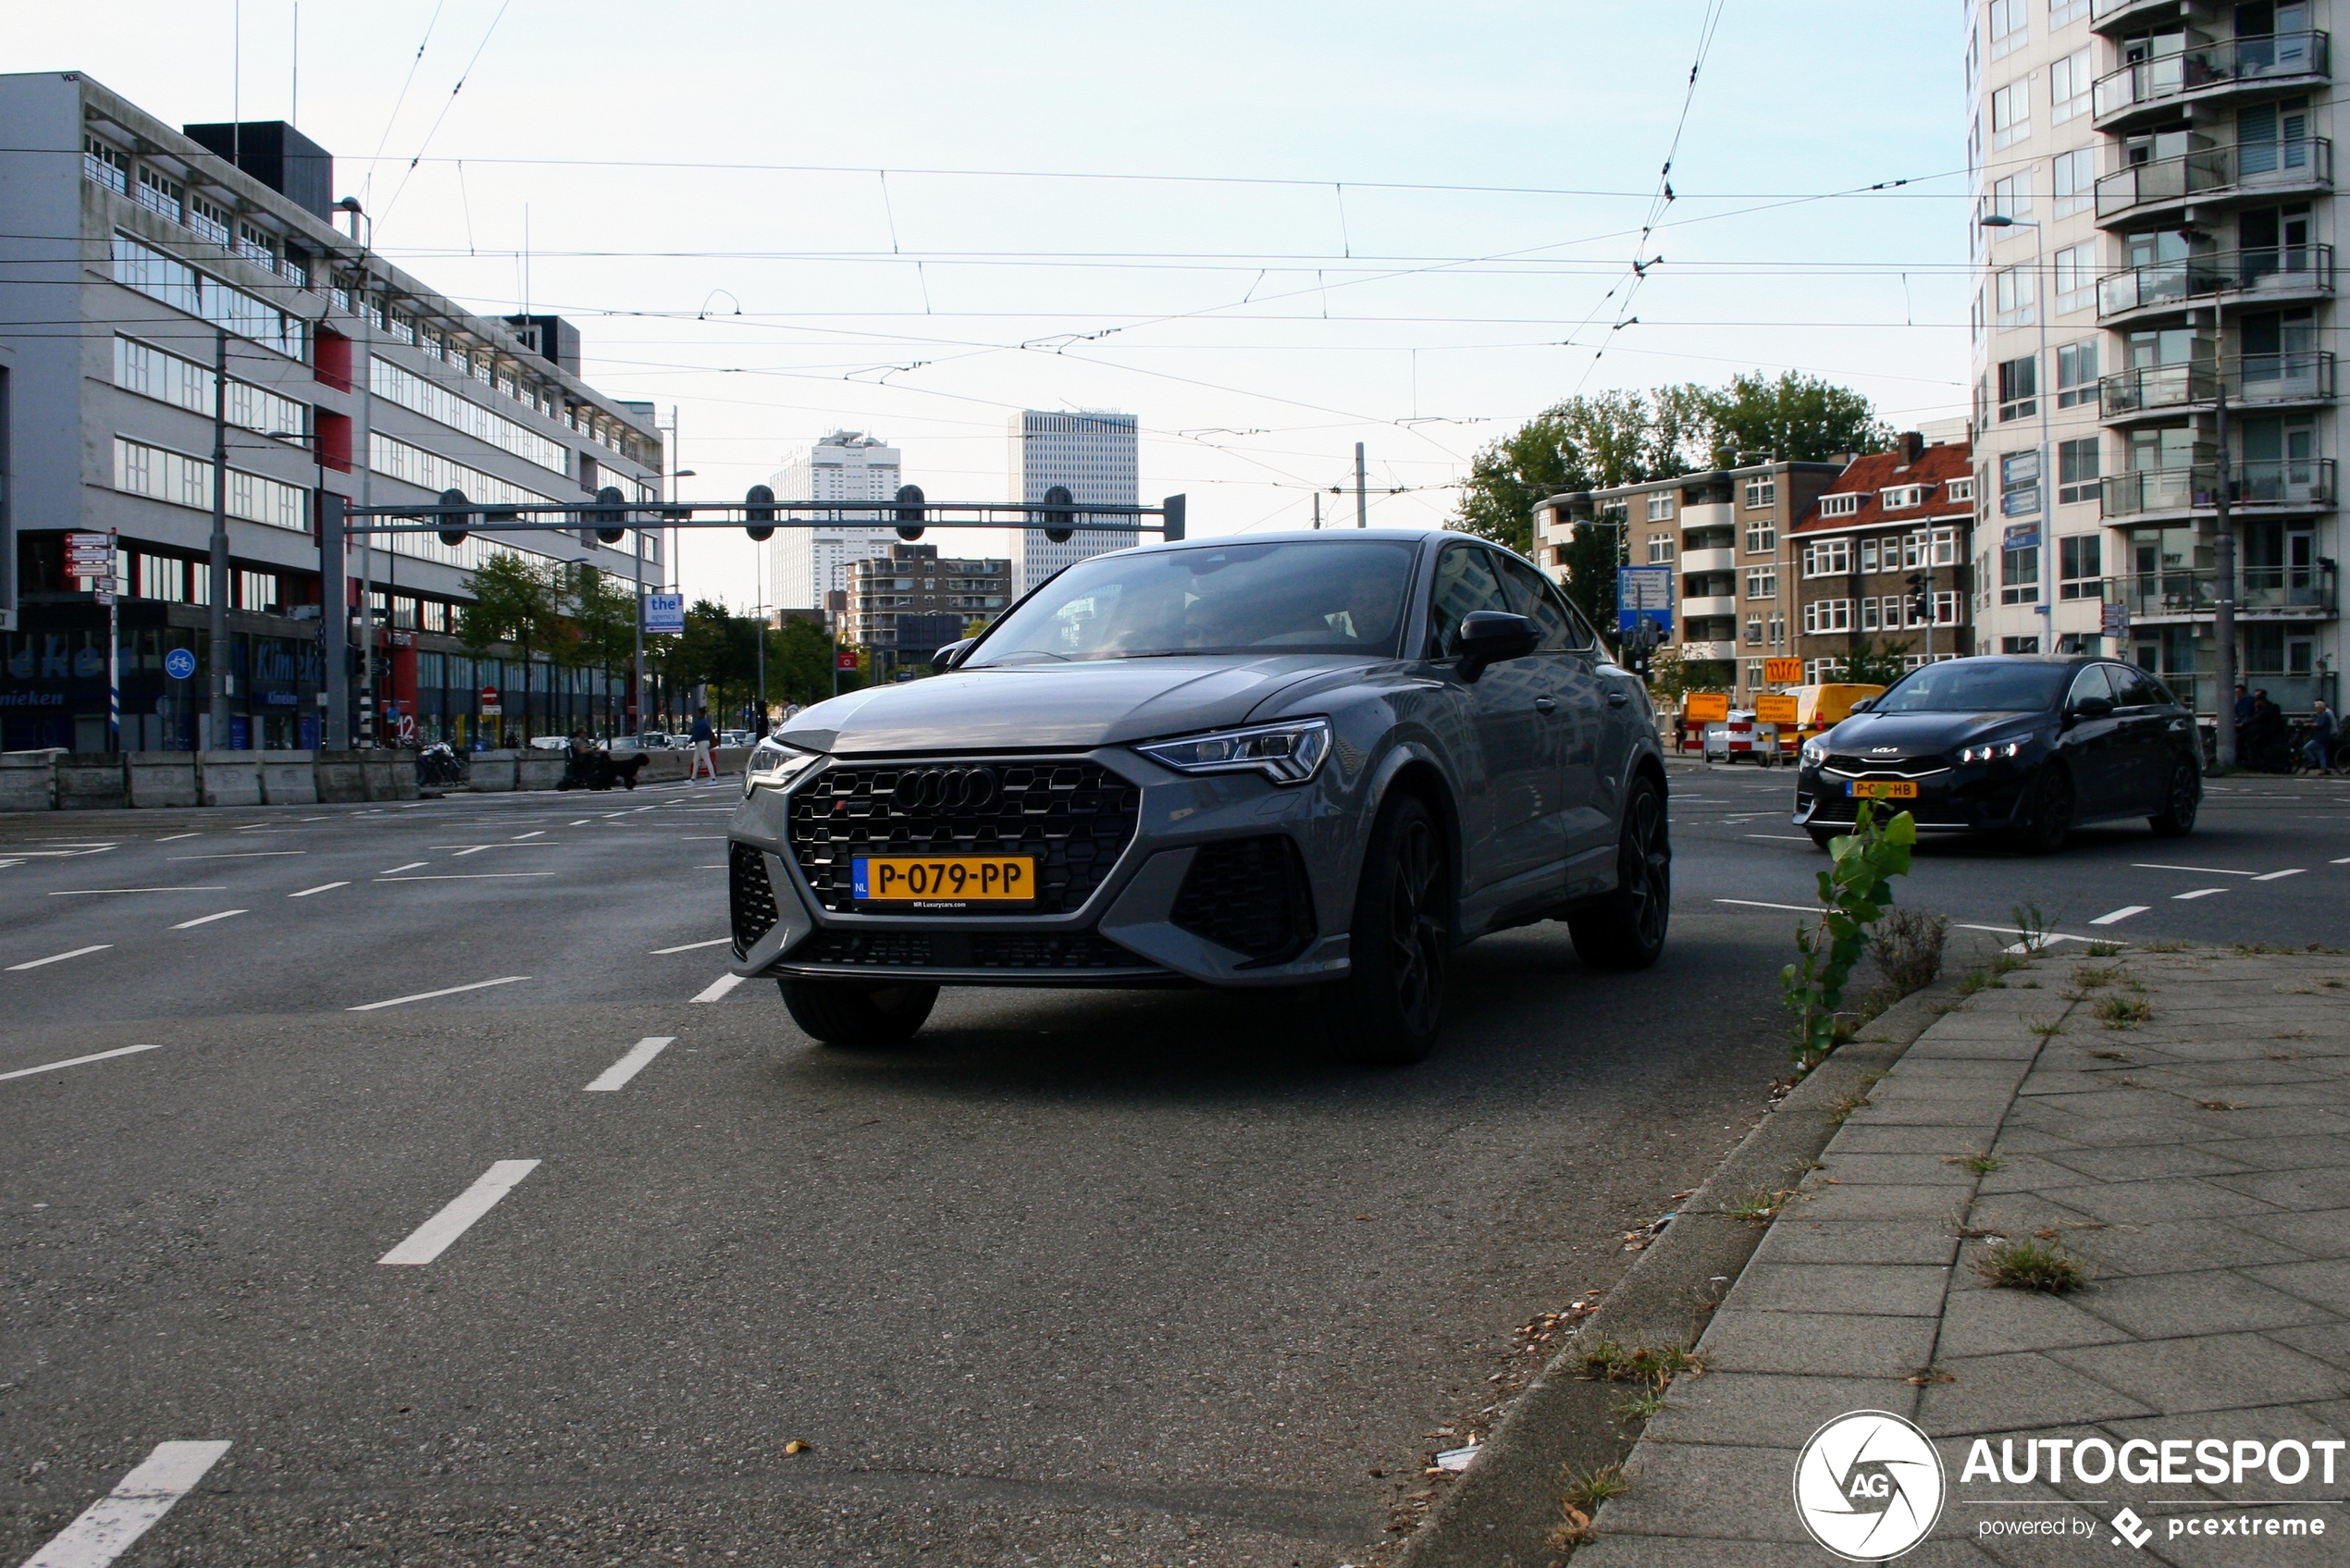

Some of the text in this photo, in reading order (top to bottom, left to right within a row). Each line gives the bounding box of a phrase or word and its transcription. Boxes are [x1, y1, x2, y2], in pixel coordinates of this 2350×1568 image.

[651, 597, 676, 611] the
[396, 715, 414, 740] 12
[855, 883, 867, 893] NL
[879, 863, 1021, 894] P-079-PP
